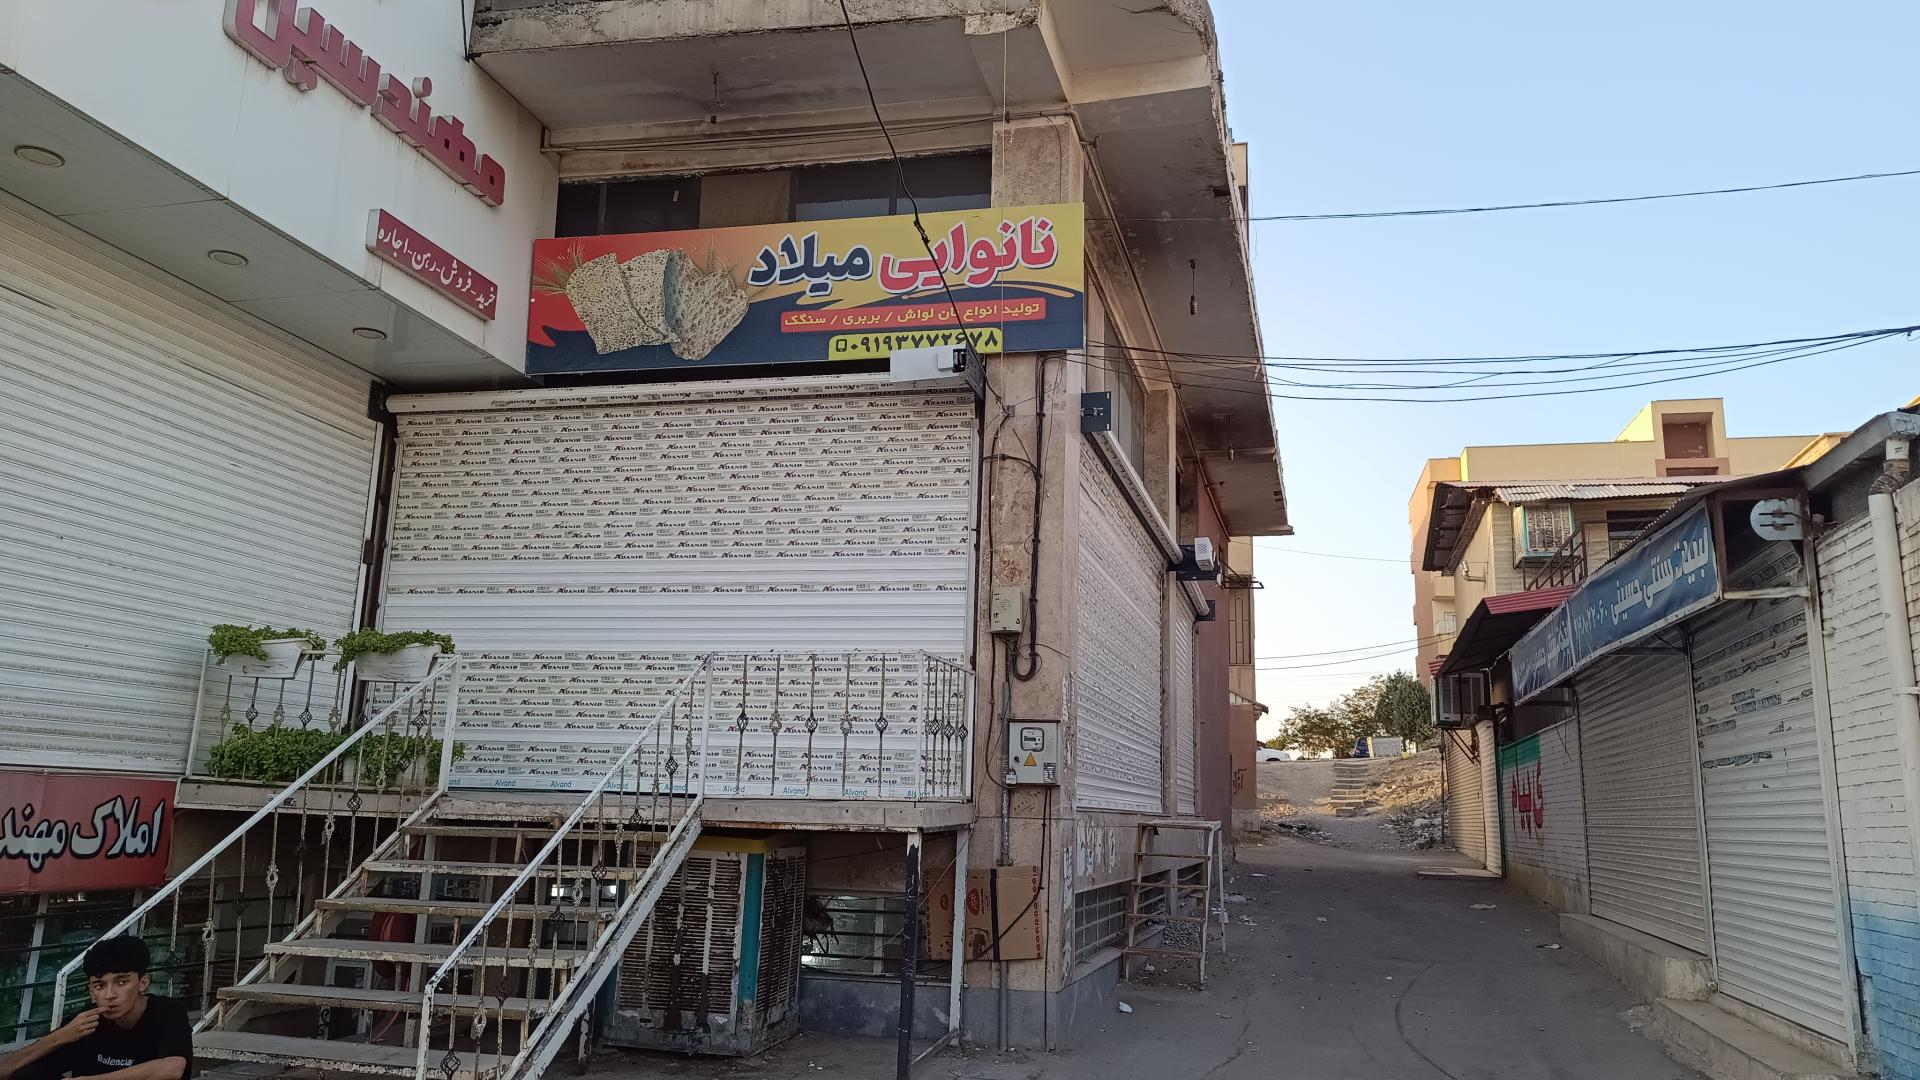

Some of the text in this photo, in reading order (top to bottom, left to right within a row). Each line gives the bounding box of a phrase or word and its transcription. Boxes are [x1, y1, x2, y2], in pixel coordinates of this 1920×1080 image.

[747, 217, 1060, 296] نانوایی میلاد
[897, 306, 934, 322] لواش
[963, 305, 998, 320] انواع
[1003, 302, 1040, 315] تولید
[784, 313, 826, 326] سنگک
[841, 312, 881, 326] بربری
[1611, 579, 1643, 626] حسینی
[71, 796, 165, 858] املاک
[97, 1054, 135, 1066] Balencia
